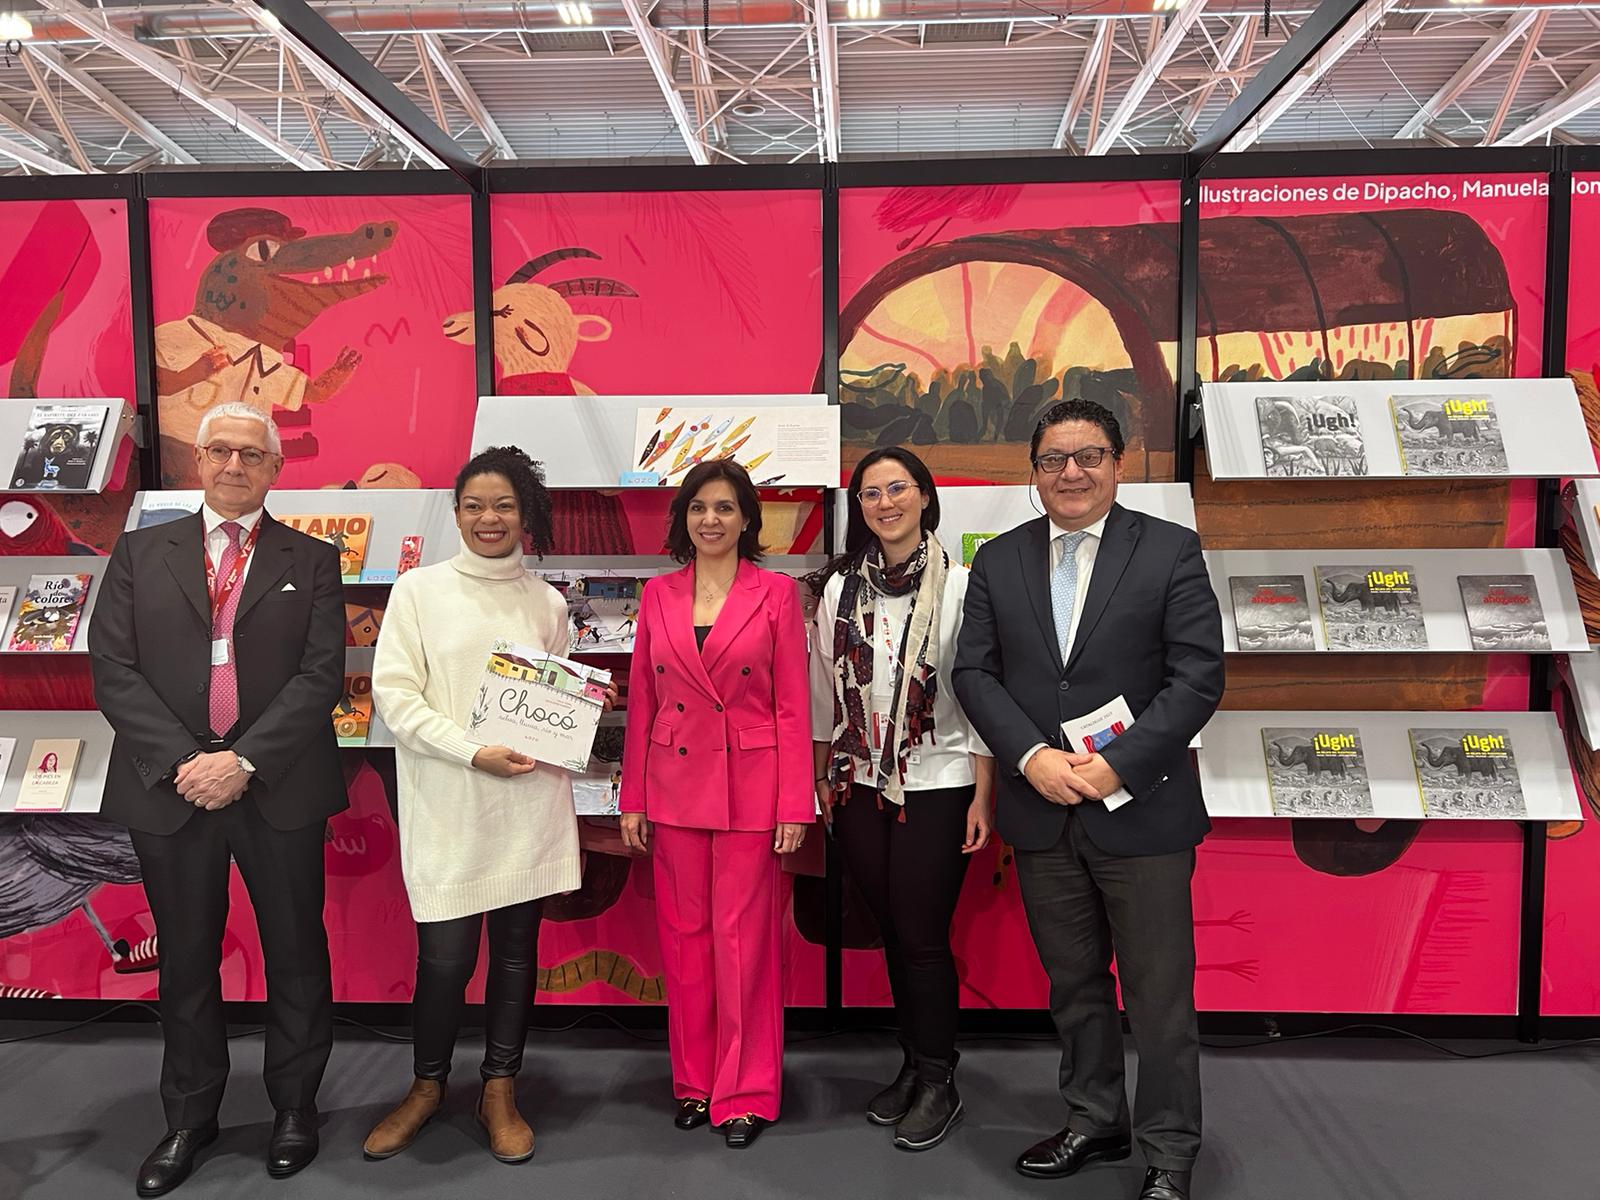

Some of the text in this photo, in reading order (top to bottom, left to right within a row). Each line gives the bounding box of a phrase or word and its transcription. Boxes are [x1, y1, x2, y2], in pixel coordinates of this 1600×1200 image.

[1199, 184, 1328, 203] Ilustraciones
[1332, 183, 1359, 201] de
[1364, 181, 1457, 204] Dipacho,
[1463, 178, 1549, 198] Manuela
[1307, 413, 1356, 432] ¡Ugh!
[44, 580, 64, 590] Río
[1367, 570, 1410, 588] ¡Ugh!
[35, 594, 75, 604] colores
[499, 688, 578, 731] Chocó
[1313, 733, 1356, 751] ¡Ugh!
[1462, 734, 1505, 752] ¡Ugh!
